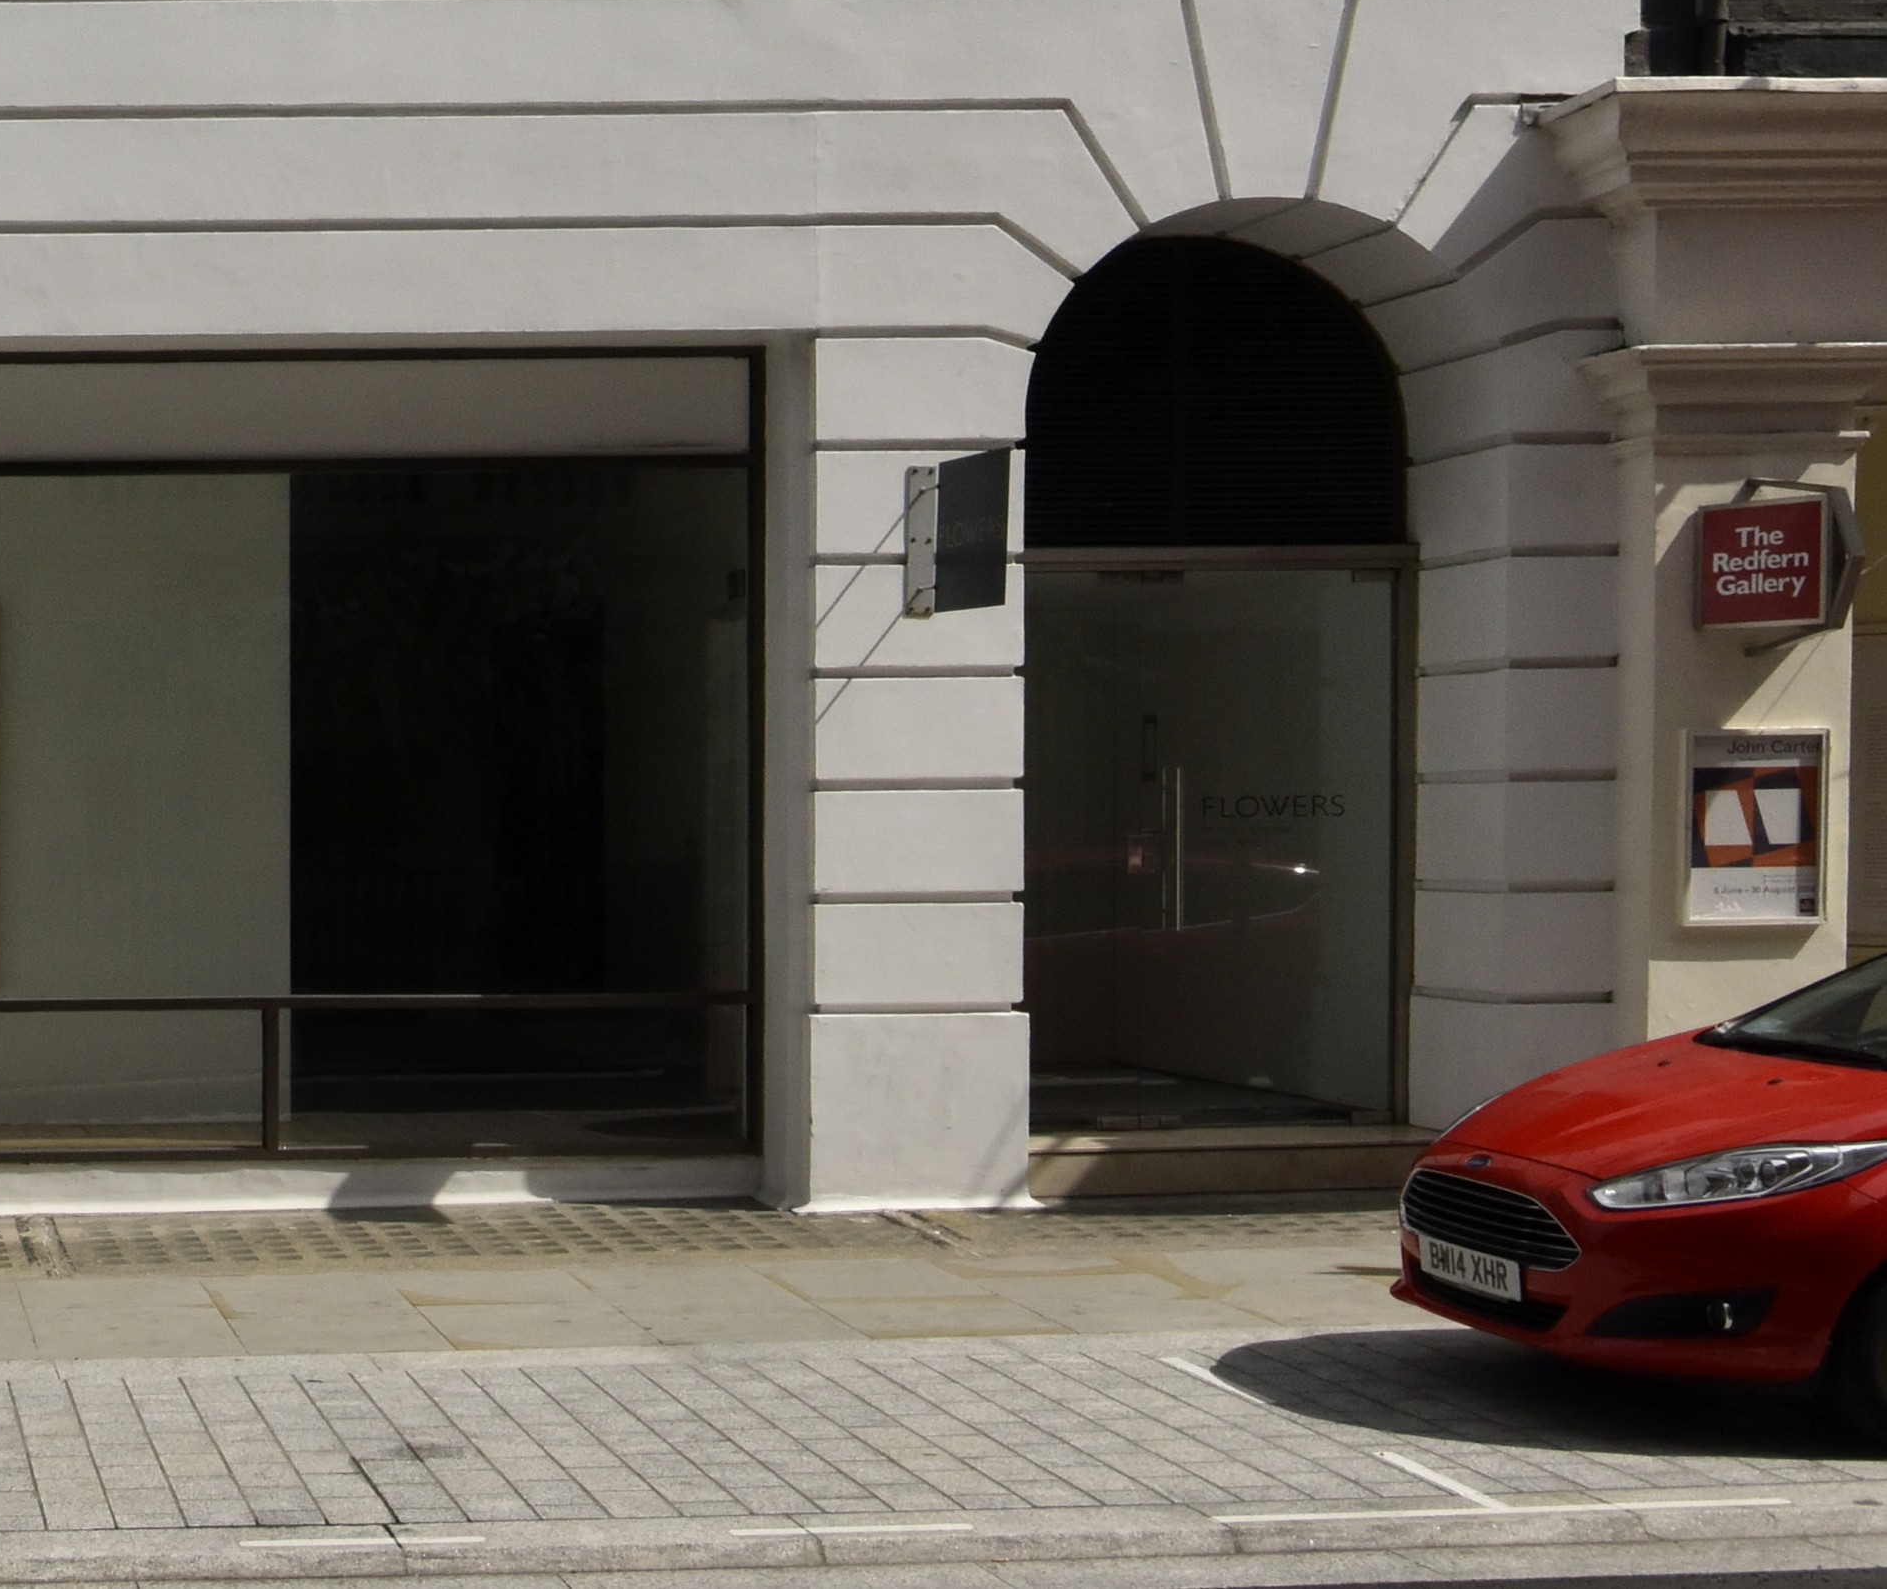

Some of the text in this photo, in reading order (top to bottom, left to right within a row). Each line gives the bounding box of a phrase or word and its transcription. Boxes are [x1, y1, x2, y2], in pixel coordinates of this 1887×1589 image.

[1735, 526, 1785, 548] The
[1712, 549, 1810, 573] Redfern
[1716, 573, 1806, 598] Gallery
[1726, 739, 1822, 754] John Carter
[1201, 794, 1346, 819] FLOWERS
[1470, 1253, 1509, 1292] XHR
